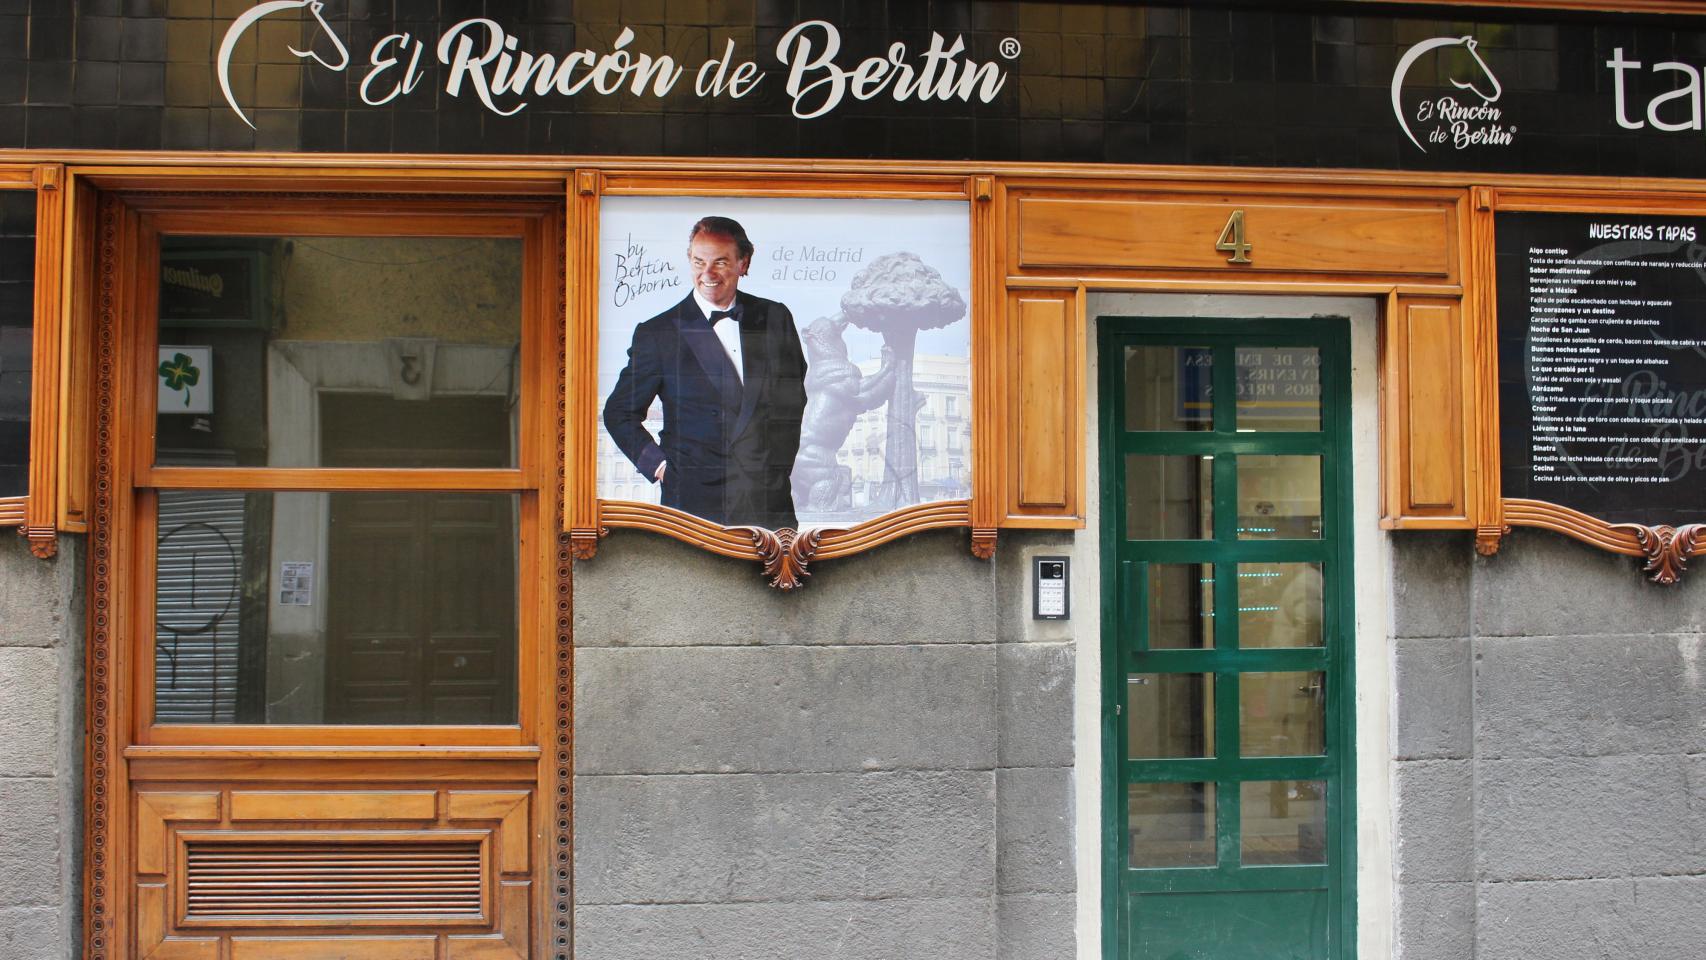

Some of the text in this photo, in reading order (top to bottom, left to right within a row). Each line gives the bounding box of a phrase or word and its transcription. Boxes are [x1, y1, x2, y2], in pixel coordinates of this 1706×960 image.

[360, 32, 422, 106] El
[436, 18, 682, 116] Rincón
[695, 38, 764, 98] de
[1606, 48, 1706, 132] ta
[1417, 97, 1501, 124] El Rincón
[1430, 126, 1448, 144] de
[1216, 210, 1252, 262] 4
[1590, 223, 1696, 241] NUESTRAS TAPAS
[628, 232, 647, 271] by
[772, 246, 864, 263] de Madrid
[772, 266, 837, 282] al cielo
[614, 274, 682, 307] Osborne
